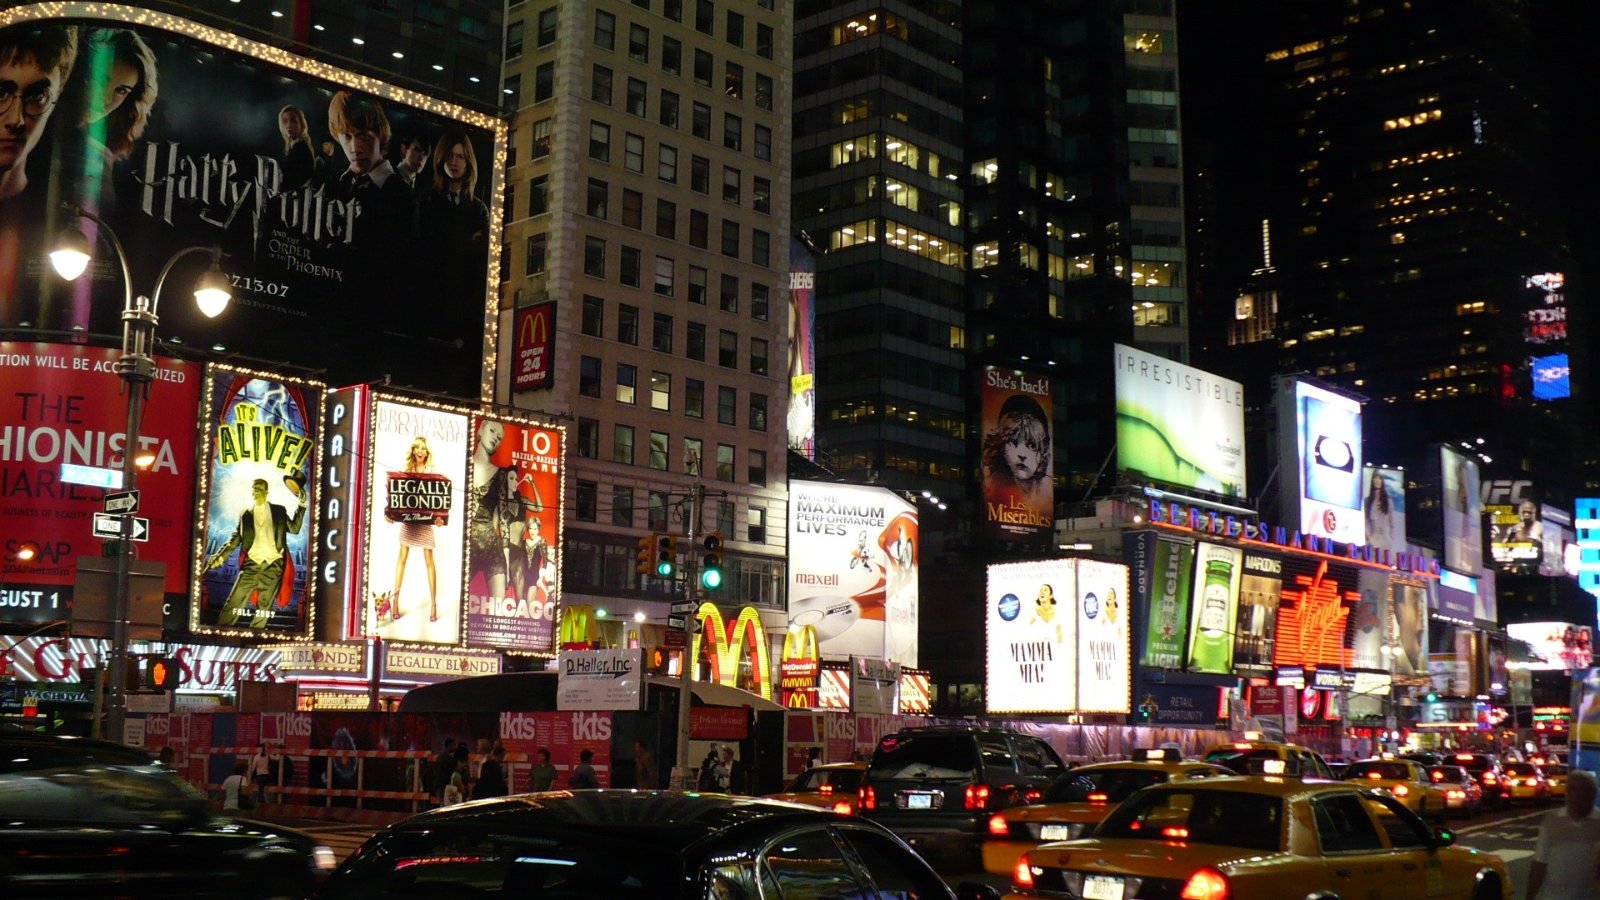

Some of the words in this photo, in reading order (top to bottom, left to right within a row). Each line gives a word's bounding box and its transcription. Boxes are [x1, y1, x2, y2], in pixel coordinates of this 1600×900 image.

[132, 140, 252, 230] Harry
[252, 154, 362, 261] Potter
[271, 229, 287, 238] AND
[268, 239, 311, 260] ORDER
[287, 255, 343, 282] PHOENIX
[225, 271, 289, 297] 7.13.07
[521, 346, 544, 358] OPEN
[36, 355, 68, 369] WILL
[73, 357, 90, 371] BE
[523, 357, 541, 372] 24
[517, 371, 546, 384] HOURS
[987, 370, 1017, 390] She's
[1020, 376, 1049, 396] back!
[1118, 353, 1242, 407] IRRESISTIBLE
[15, 392, 85, 425] THE
[377, 421, 411, 437] GOES
[379, 406, 464, 436] BROADWAY
[219, 422, 314, 477] ALIVE!
[521, 429, 551, 455] 10
[511, 460, 558, 474] YEARS
[324, 403, 345, 584] PALACE
[390, 479, 451, 495] LEGALLY
[390, 494, 451, 510] BLONDE
[797, 501, 885, 519] MAXIMUM
[1010, 495, 1026, 510] Les
[102, 521, 118, 531] ONE
[796, 513, 885, 527] PERFORMANCE
[796, 521, 848, 536] LIVES
[1150, 499, 1334, 555] BERTELSMANN
[4, 537, 73, 565] SOAP
[1137, 533, 1146, 594] VORNADO
[795, 573, 839, 586] maxell
[50, 592, 59, 609] 1
[468, 594, 555, 621] CHICAGO
[232, 608, 252, 617] FALL
[499, 624, 527, 632] BROADWAY
[299, 649, 357, 665] BLONDE
[1010, 641, 1053, 663] MAMMA
[1089, 640, 1117, 661] MAMMA
[388, 655, 442, 670] LEGALLY
[446, 656, 498, 674] BLONDE
[612, 656, 633, 671] Inc.
[782, 663, 817, 671] McDonald's
[1149, 653, 1180, 668] LIGHT
[1020, 663, 1045, 683] MIA!
[1095, 661, 1112, 681] MIA!
[1170, 696, 1193, 707] RETAIL
[146, 713, 169, 735] tkts
[285, 712, 312, 736] tkts
[1158, 709, 1203, 720] OPPORTUNITY
[500, 711, 535, 740] tkts
[572, 711, 612, 741] tkts
[827, 712, 856, 740] tkts
